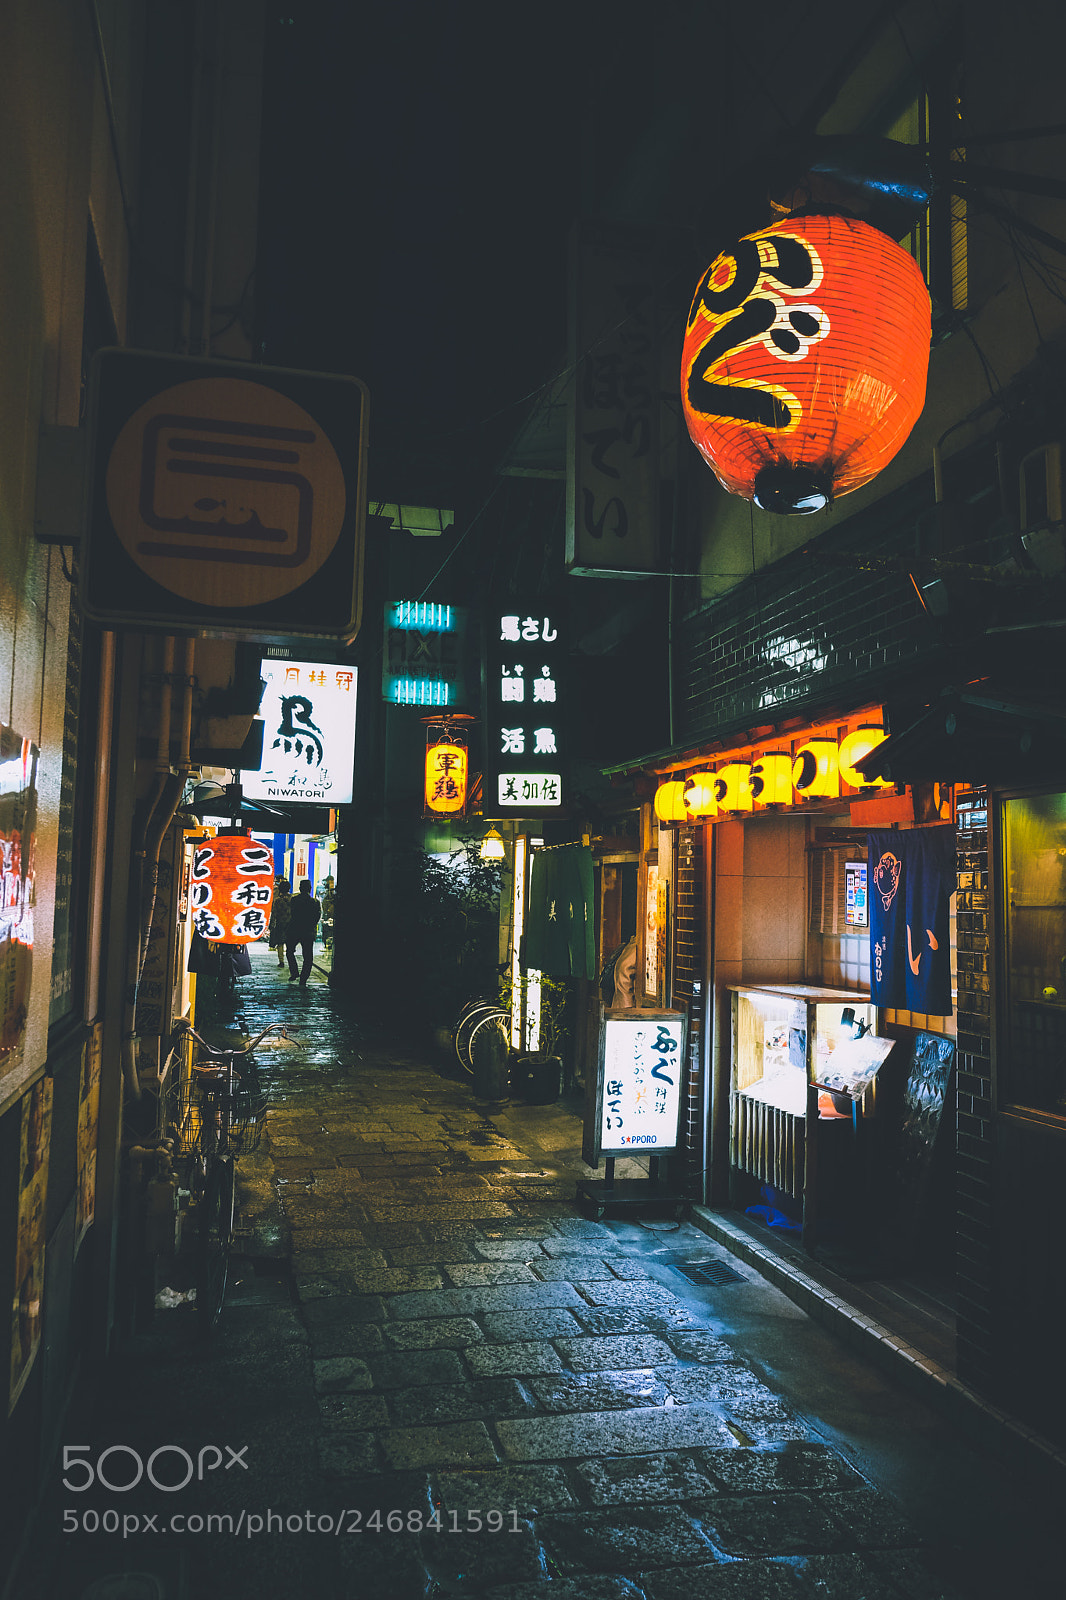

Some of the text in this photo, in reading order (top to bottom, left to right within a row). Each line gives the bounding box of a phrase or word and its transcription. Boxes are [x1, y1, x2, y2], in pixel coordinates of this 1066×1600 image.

[500, 615, 558, 642] 馬さし
[284, 667, 354, 692] 月桂冠
[500, 727, 558, 754] 活魚
[431, 753, 460, 802] 軍鶏
[501, 776, 559, 802] 美加佐
[267, 787, 325, 798] NIWATORI
[234, 848, 272, 937] 二和鳥
[906, 924, 939, 976] い
[605, 1079, 624, 1131] ほてい
